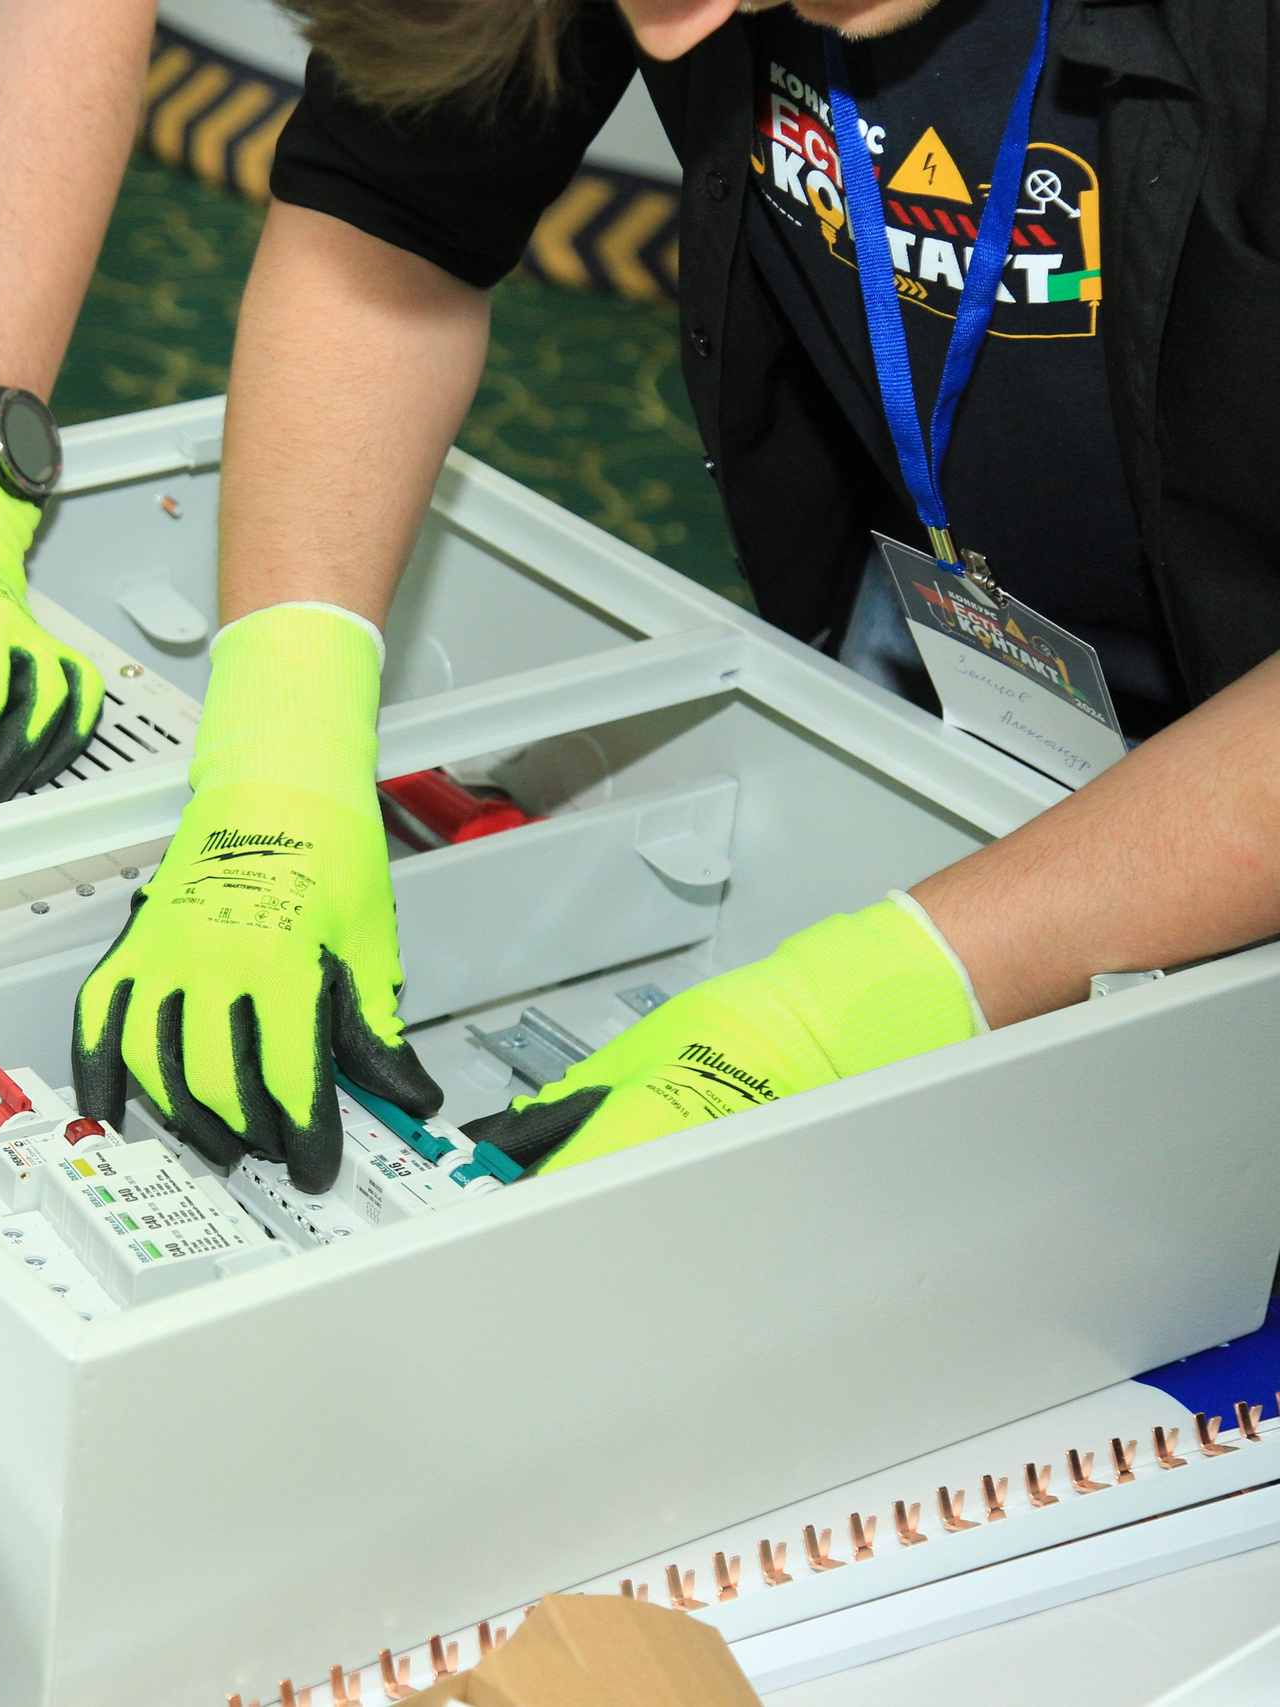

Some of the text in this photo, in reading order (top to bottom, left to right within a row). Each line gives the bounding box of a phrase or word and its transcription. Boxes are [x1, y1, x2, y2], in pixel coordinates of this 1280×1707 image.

[948, 590, 998, 620] КОНКУРС
[951, 600, 1004, 638] ЕСТЬ
[957, 616, 1060, 684] КОНТАКТ
[1074, 697, 1106, 723] 2024
[200, 829, 304, 855] Milwaukee
[242, 870, 269, 879] LEVEL
[664, 1084, 680, 1096] 9/L
[706, 1089, 723, 1105] CUT
[646, 1084, 690, 1119] 4932479918
[3, 1145, 25, 1168] DEKraft
[57, 1161, 80, 1182] DEKraft
[96, 1162, 117, 1178] C40
[370, 1159, 395, 1179] DEKraft
[389, 1162, 411, 1177] C16
[81, 1187, 103, 1209] DEKraft
[118, 1186, 138, 1203] C40
[104, 1215, 125, 1236] DEKraft
[141, 1214, 162, 1231] C40
[128, 1243, 150, 1264] DEKraft
[165, 1241, 187, 1258] C40
